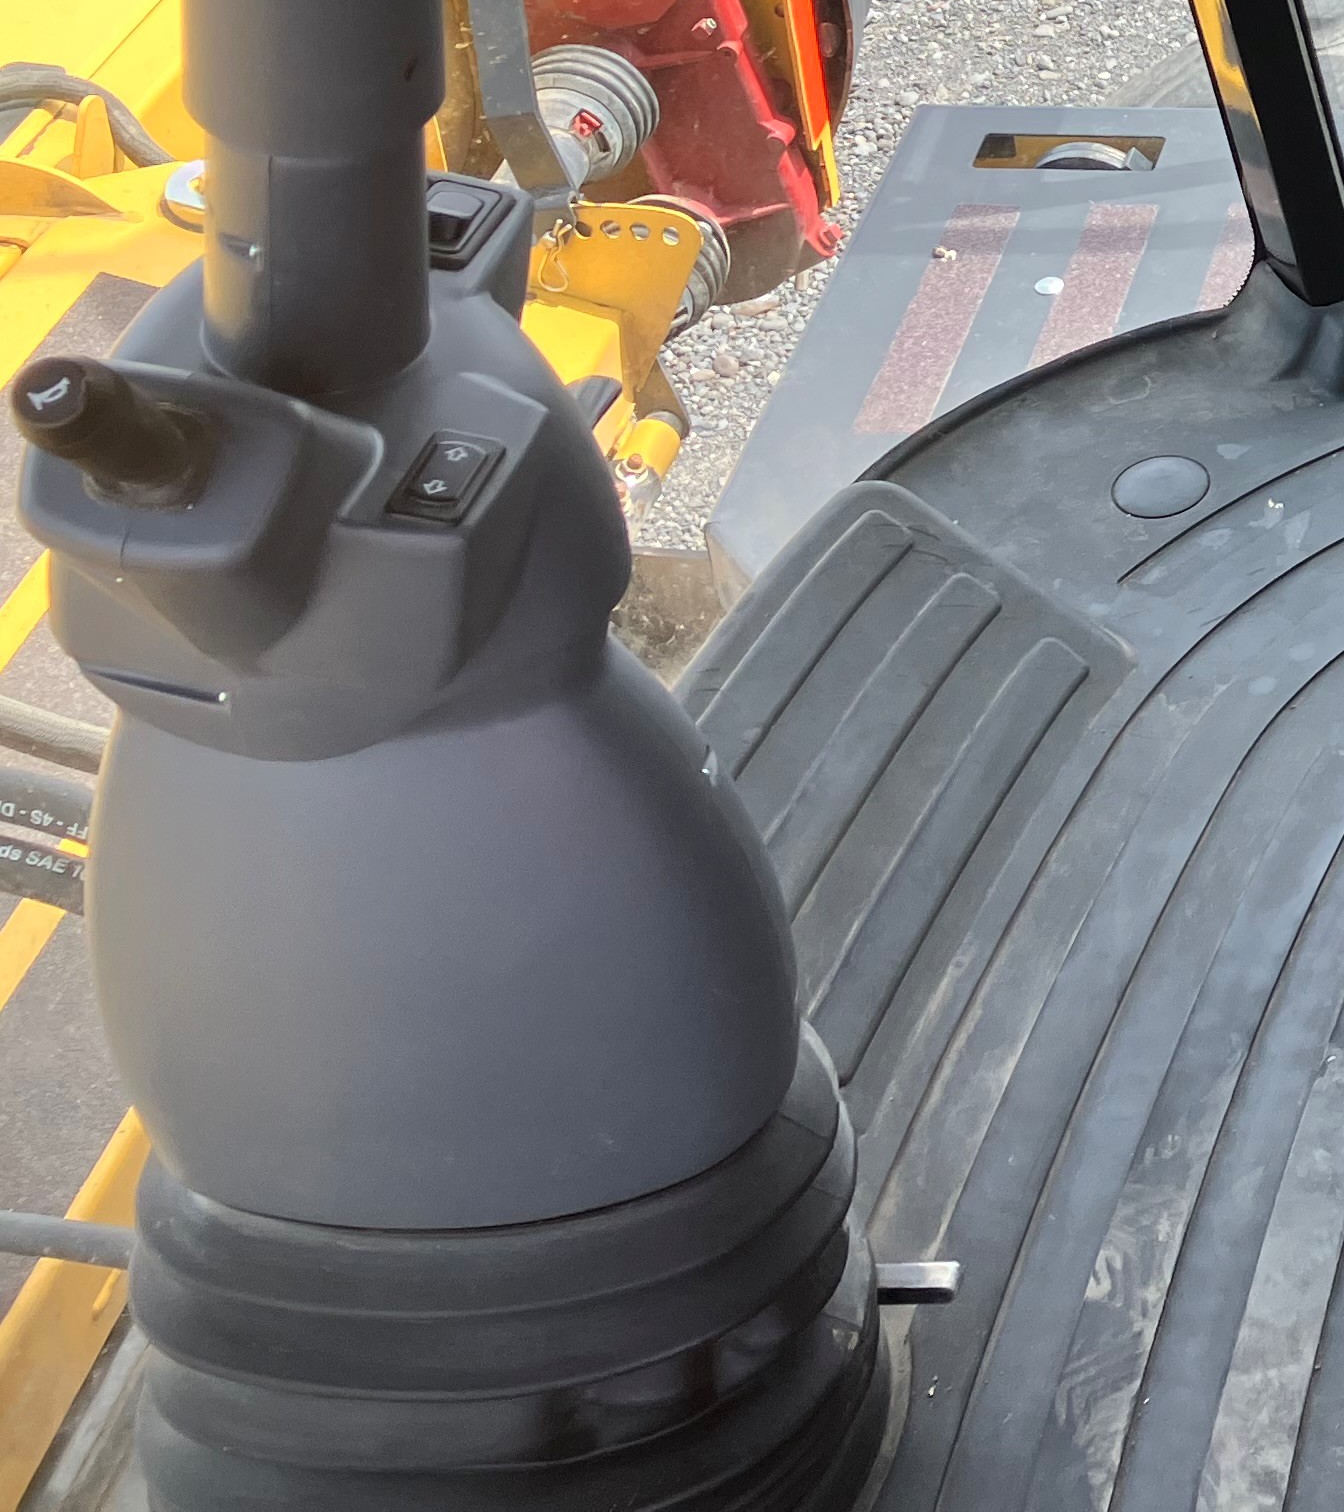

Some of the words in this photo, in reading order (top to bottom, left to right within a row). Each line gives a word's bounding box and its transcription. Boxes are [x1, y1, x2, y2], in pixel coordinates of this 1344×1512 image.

[0, 799, 16, 818] D
[29, 809, 55, 827] 4S
[25, 850, 71, 874] SAE
